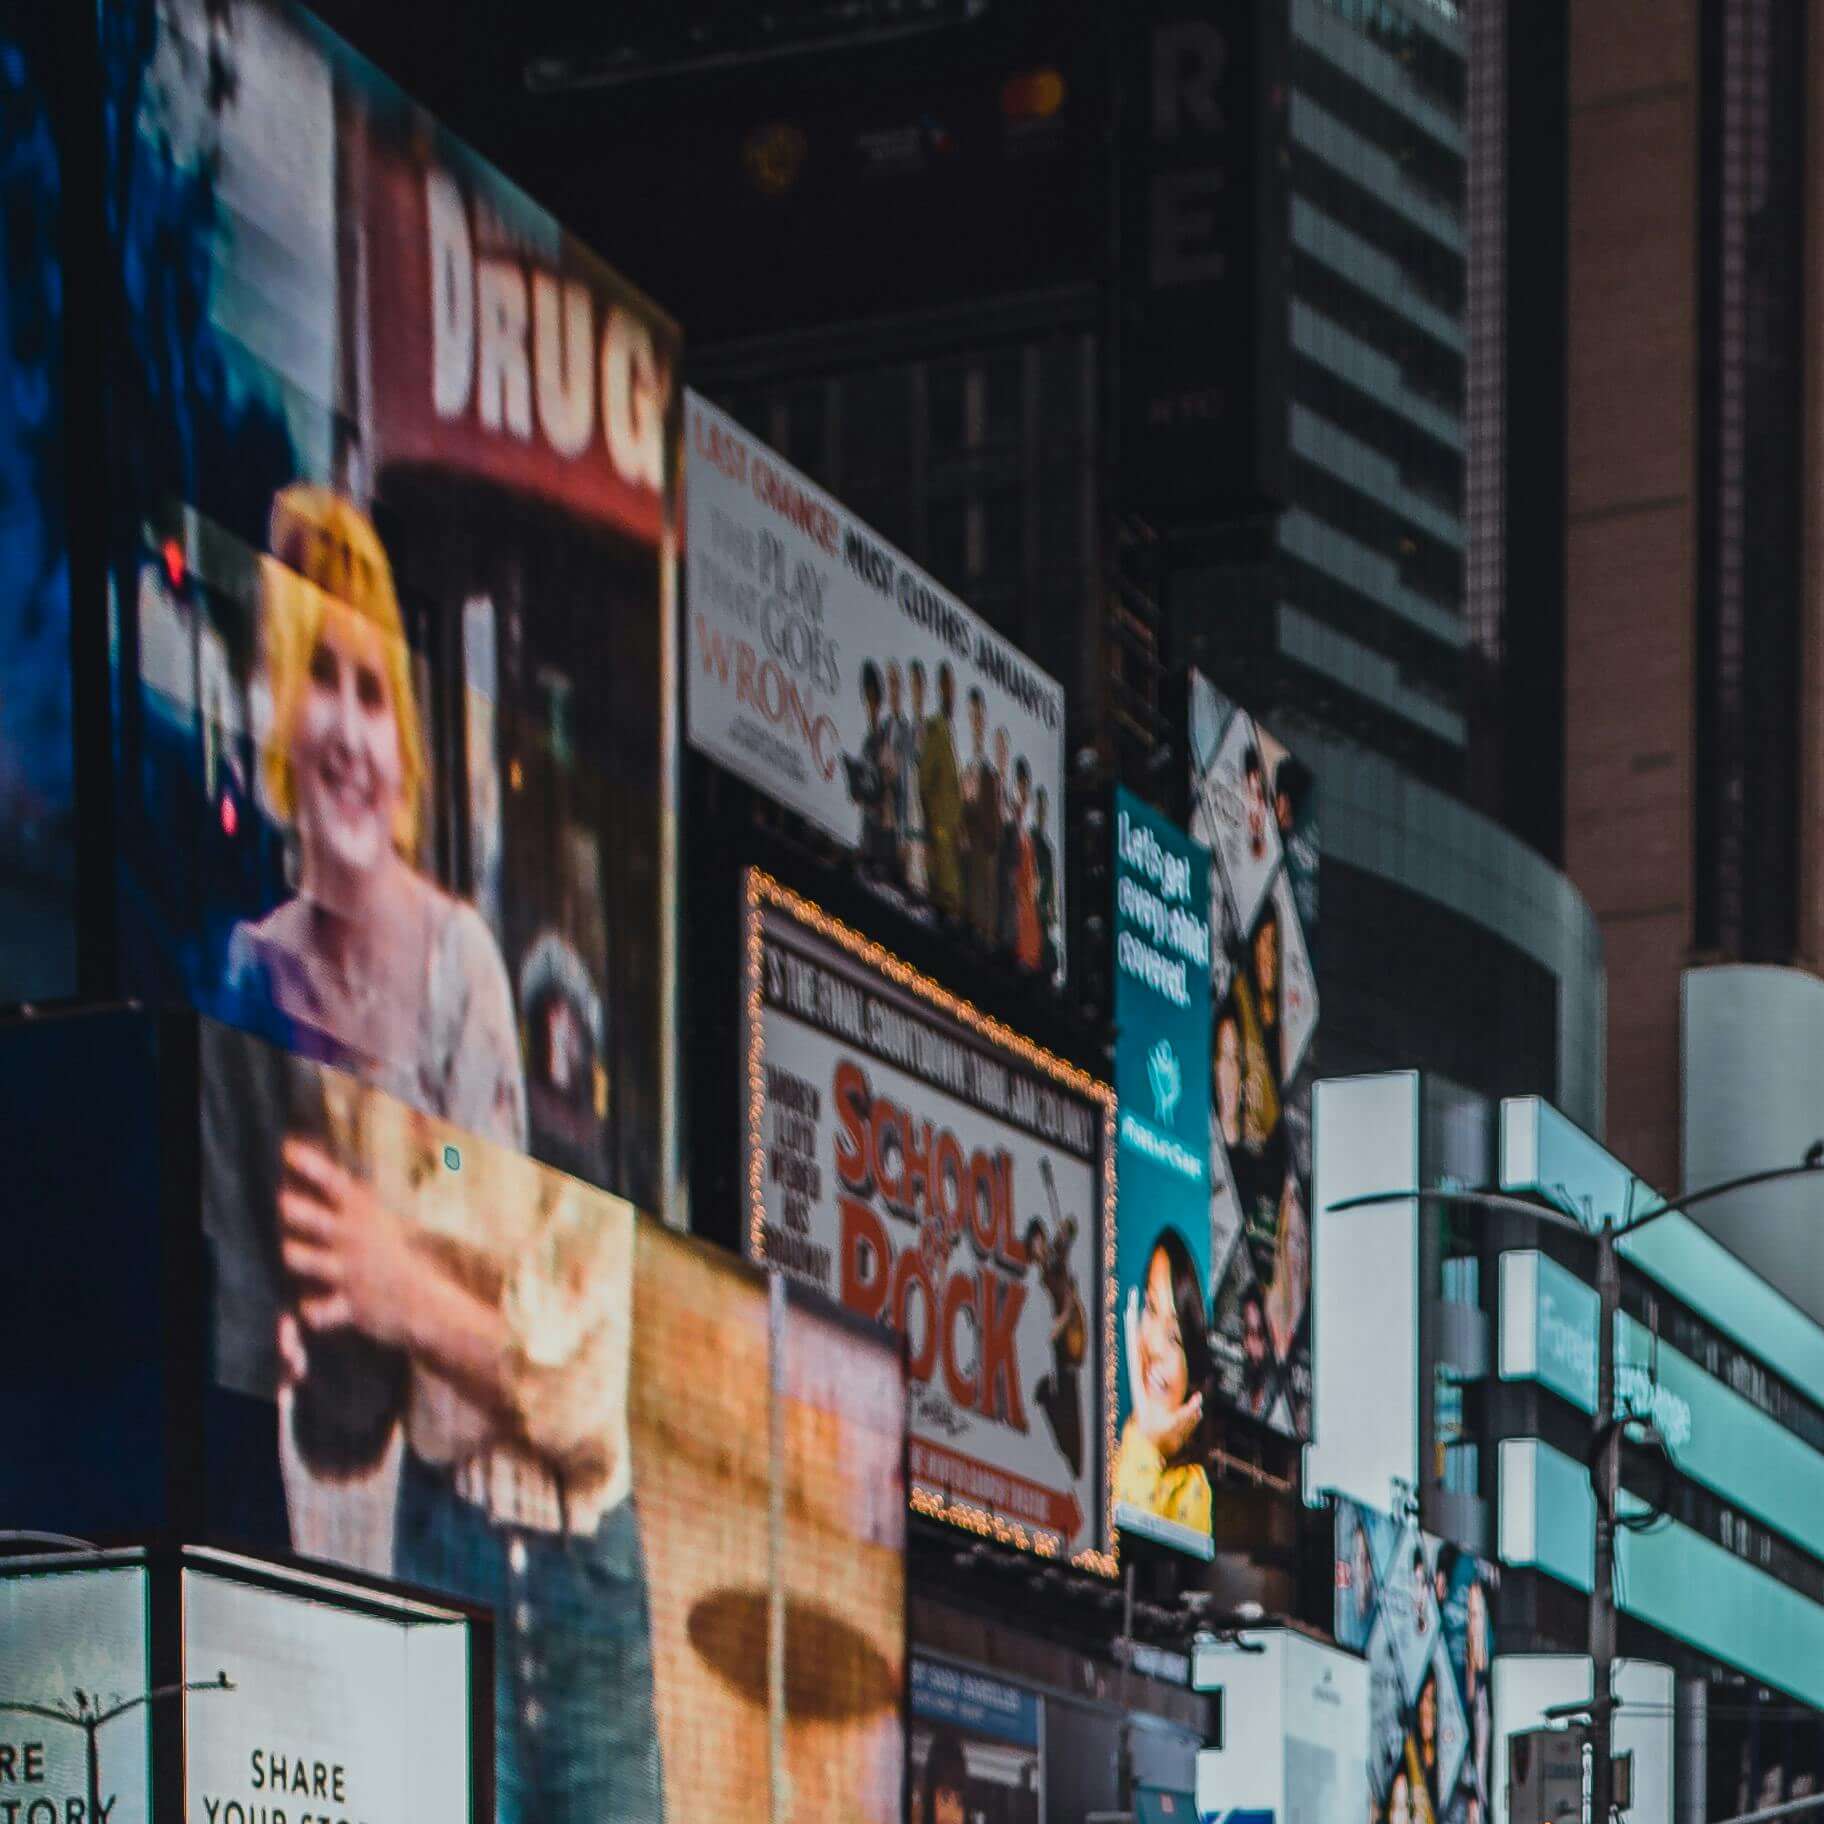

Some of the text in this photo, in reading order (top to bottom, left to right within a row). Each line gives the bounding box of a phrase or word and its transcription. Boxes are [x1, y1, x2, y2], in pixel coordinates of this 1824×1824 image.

[424, 168, 664, 493] DRUG
[695, 612, 841, 783] WRONG
[835, 1058, 1030, 1277] SCHOOL
[836, 1193, 1028, 1436] ROCK
[250, 1748, 346, 1803] SHARE
